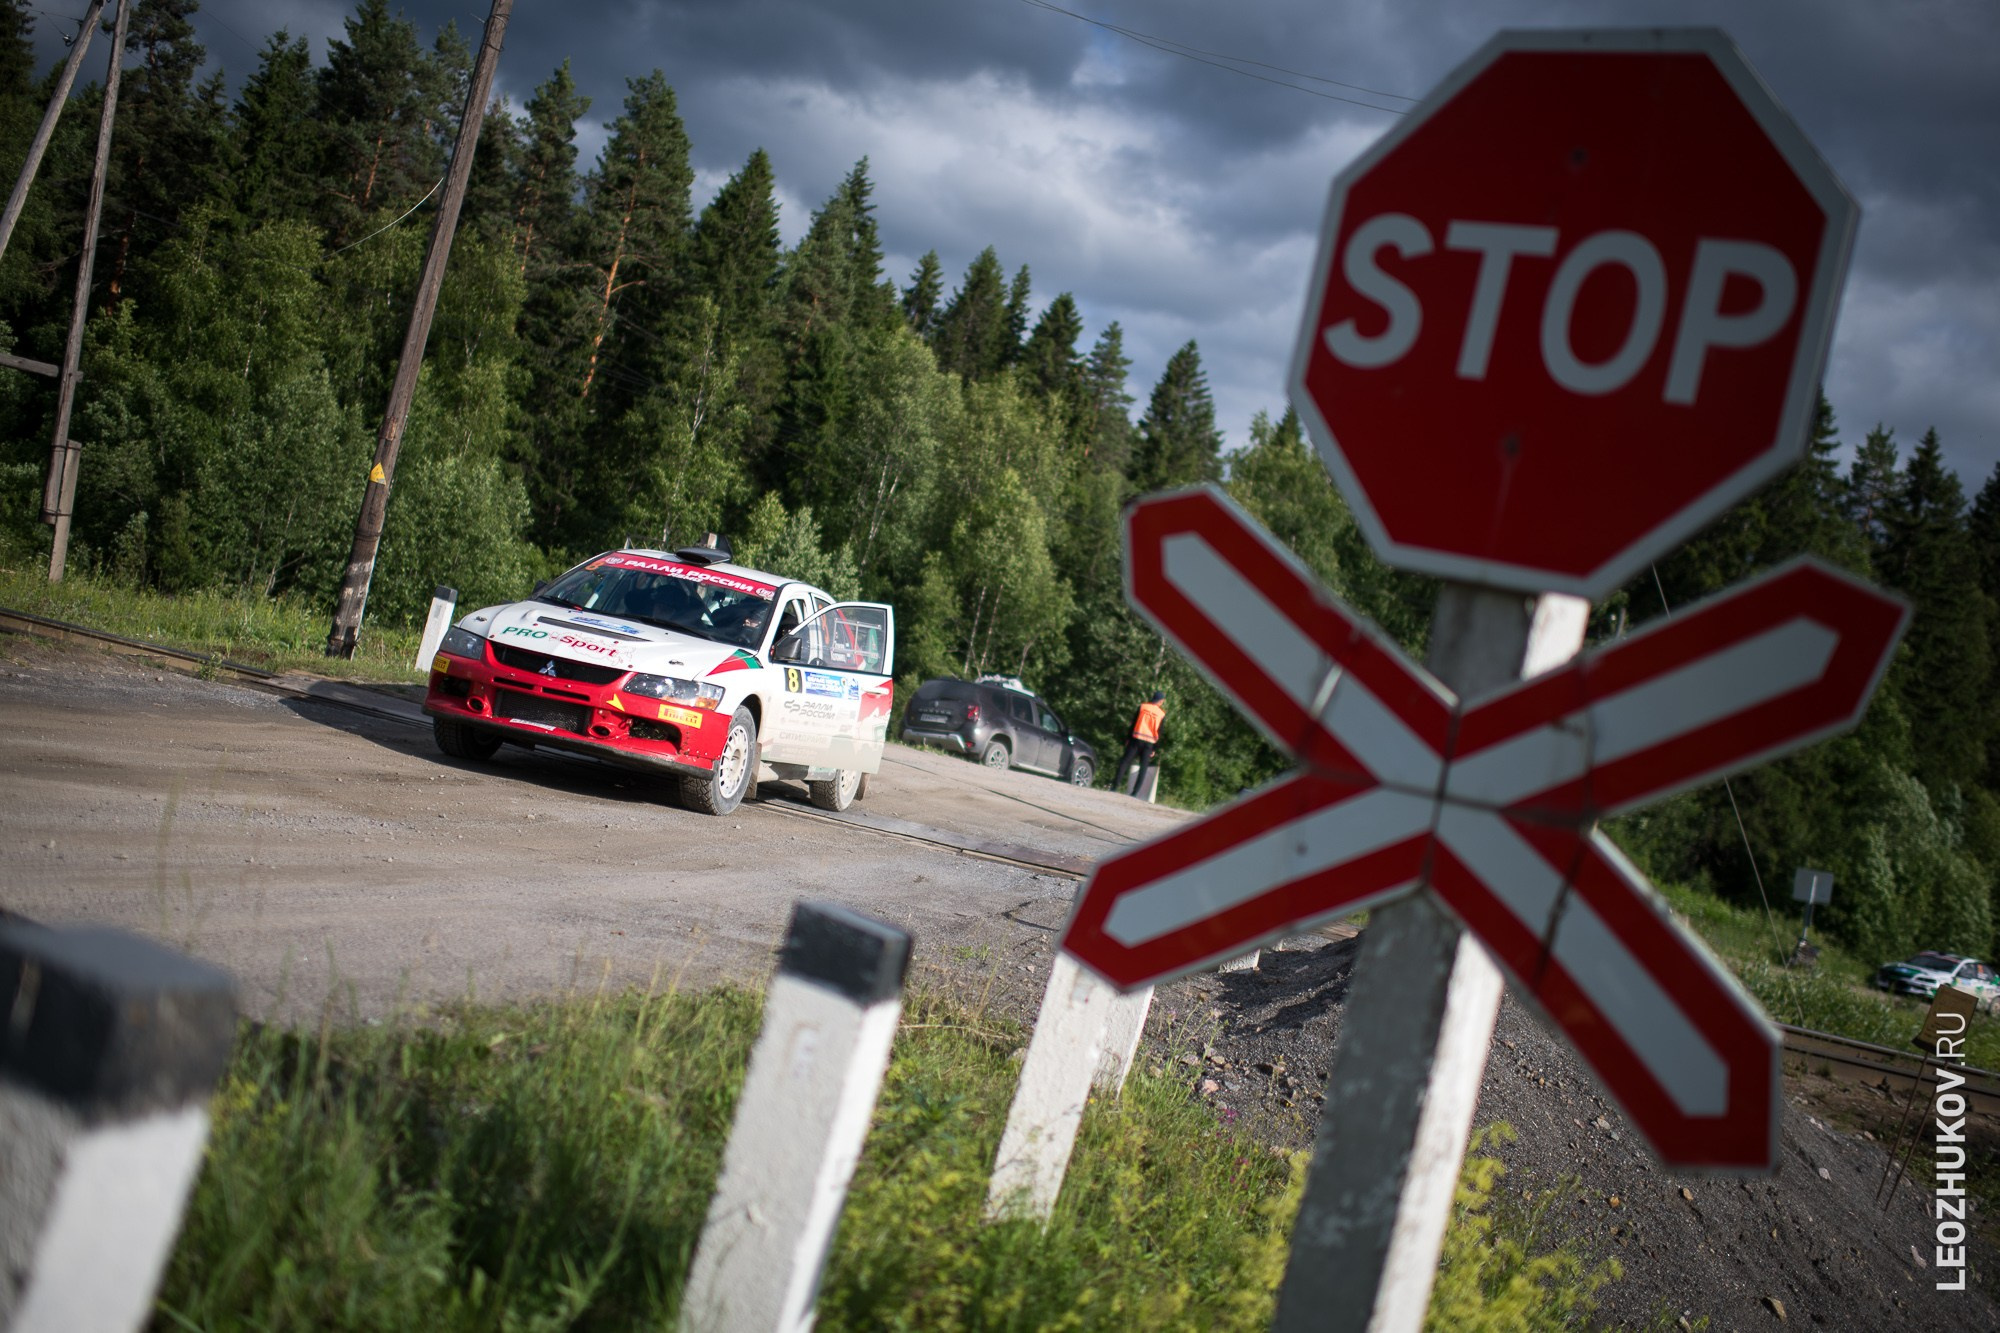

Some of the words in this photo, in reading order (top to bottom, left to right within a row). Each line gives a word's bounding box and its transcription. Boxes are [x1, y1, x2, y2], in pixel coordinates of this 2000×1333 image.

[1322, 212, 1798, 406] STOP
[624, 559, 683, 575] РАЛЛИ
[687, 569, 754, 592] РОССИИ
[788, 667, 800, 693] 8
[800, 708, 836, 720] РОССИИ
[803, 701, 833, 711] РАЛЛИ
